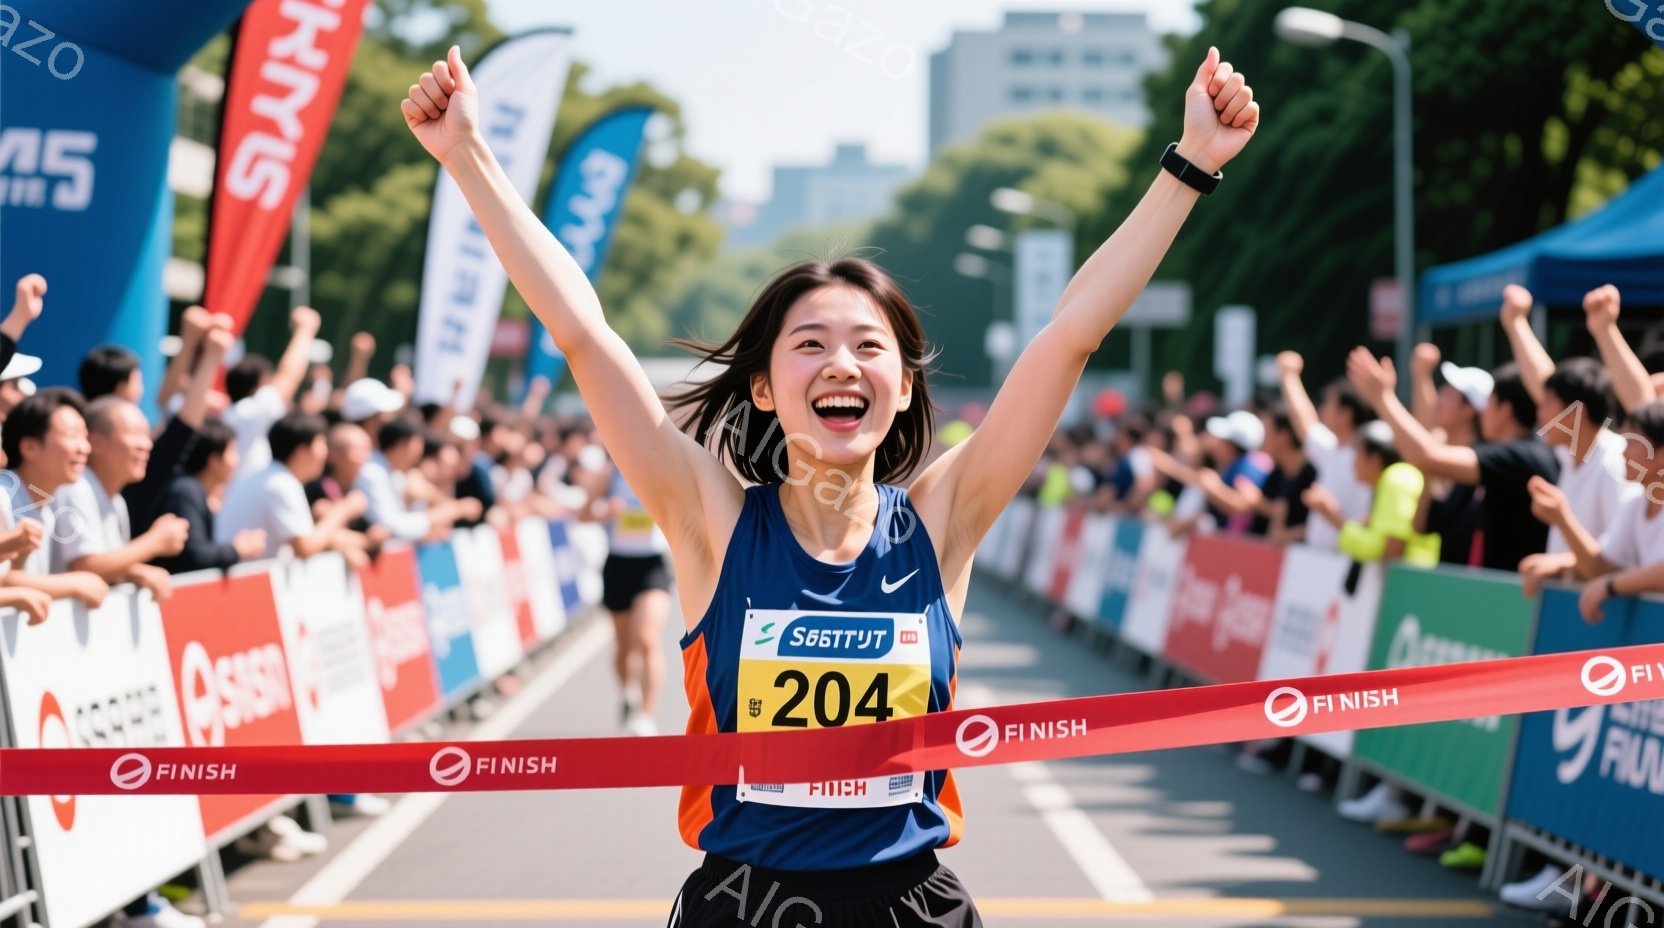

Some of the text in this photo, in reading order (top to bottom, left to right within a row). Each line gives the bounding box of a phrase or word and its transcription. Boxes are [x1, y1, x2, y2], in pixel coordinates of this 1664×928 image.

[771, 669, 893, 728] 204
[1312, 687, 1399, 714] FINISH
[1004, 718, 1087, 744] FINISH
[156, 763, 237, 780] FINISH
[476, 756, 557, 774] FINISH
